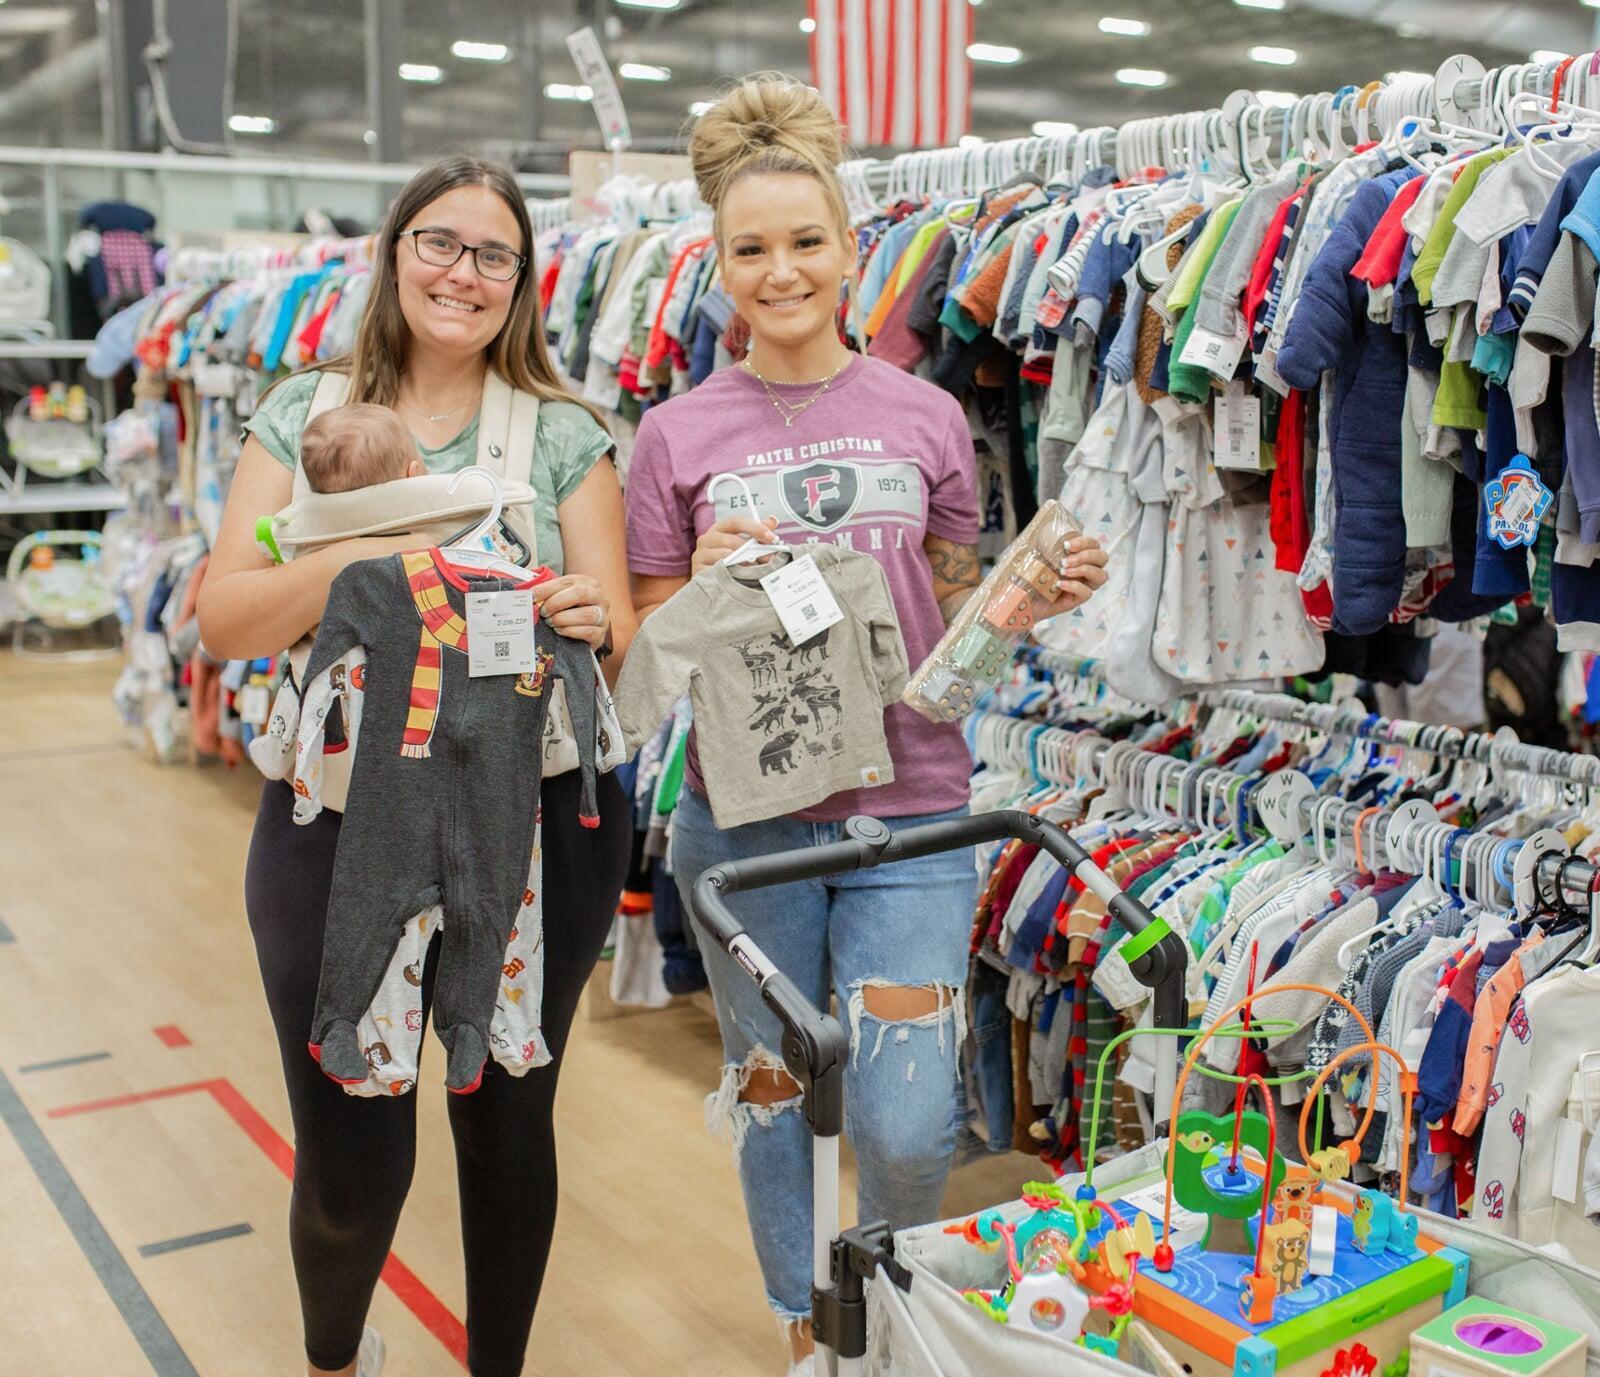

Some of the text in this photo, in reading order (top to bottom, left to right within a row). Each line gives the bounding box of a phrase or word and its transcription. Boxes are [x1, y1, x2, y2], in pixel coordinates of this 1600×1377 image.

[747, 438, 883, 466] FAITH CHRISTIAN
[730, 478, 908, 509] EST. 1973
[801, 468, 841, 522] F
[1280, 773, 1294, 786] W
[1263, 797, 1277, 811] W
[1409, 807, 1419, 820] V
[1390, 835, 1400, 849] V
